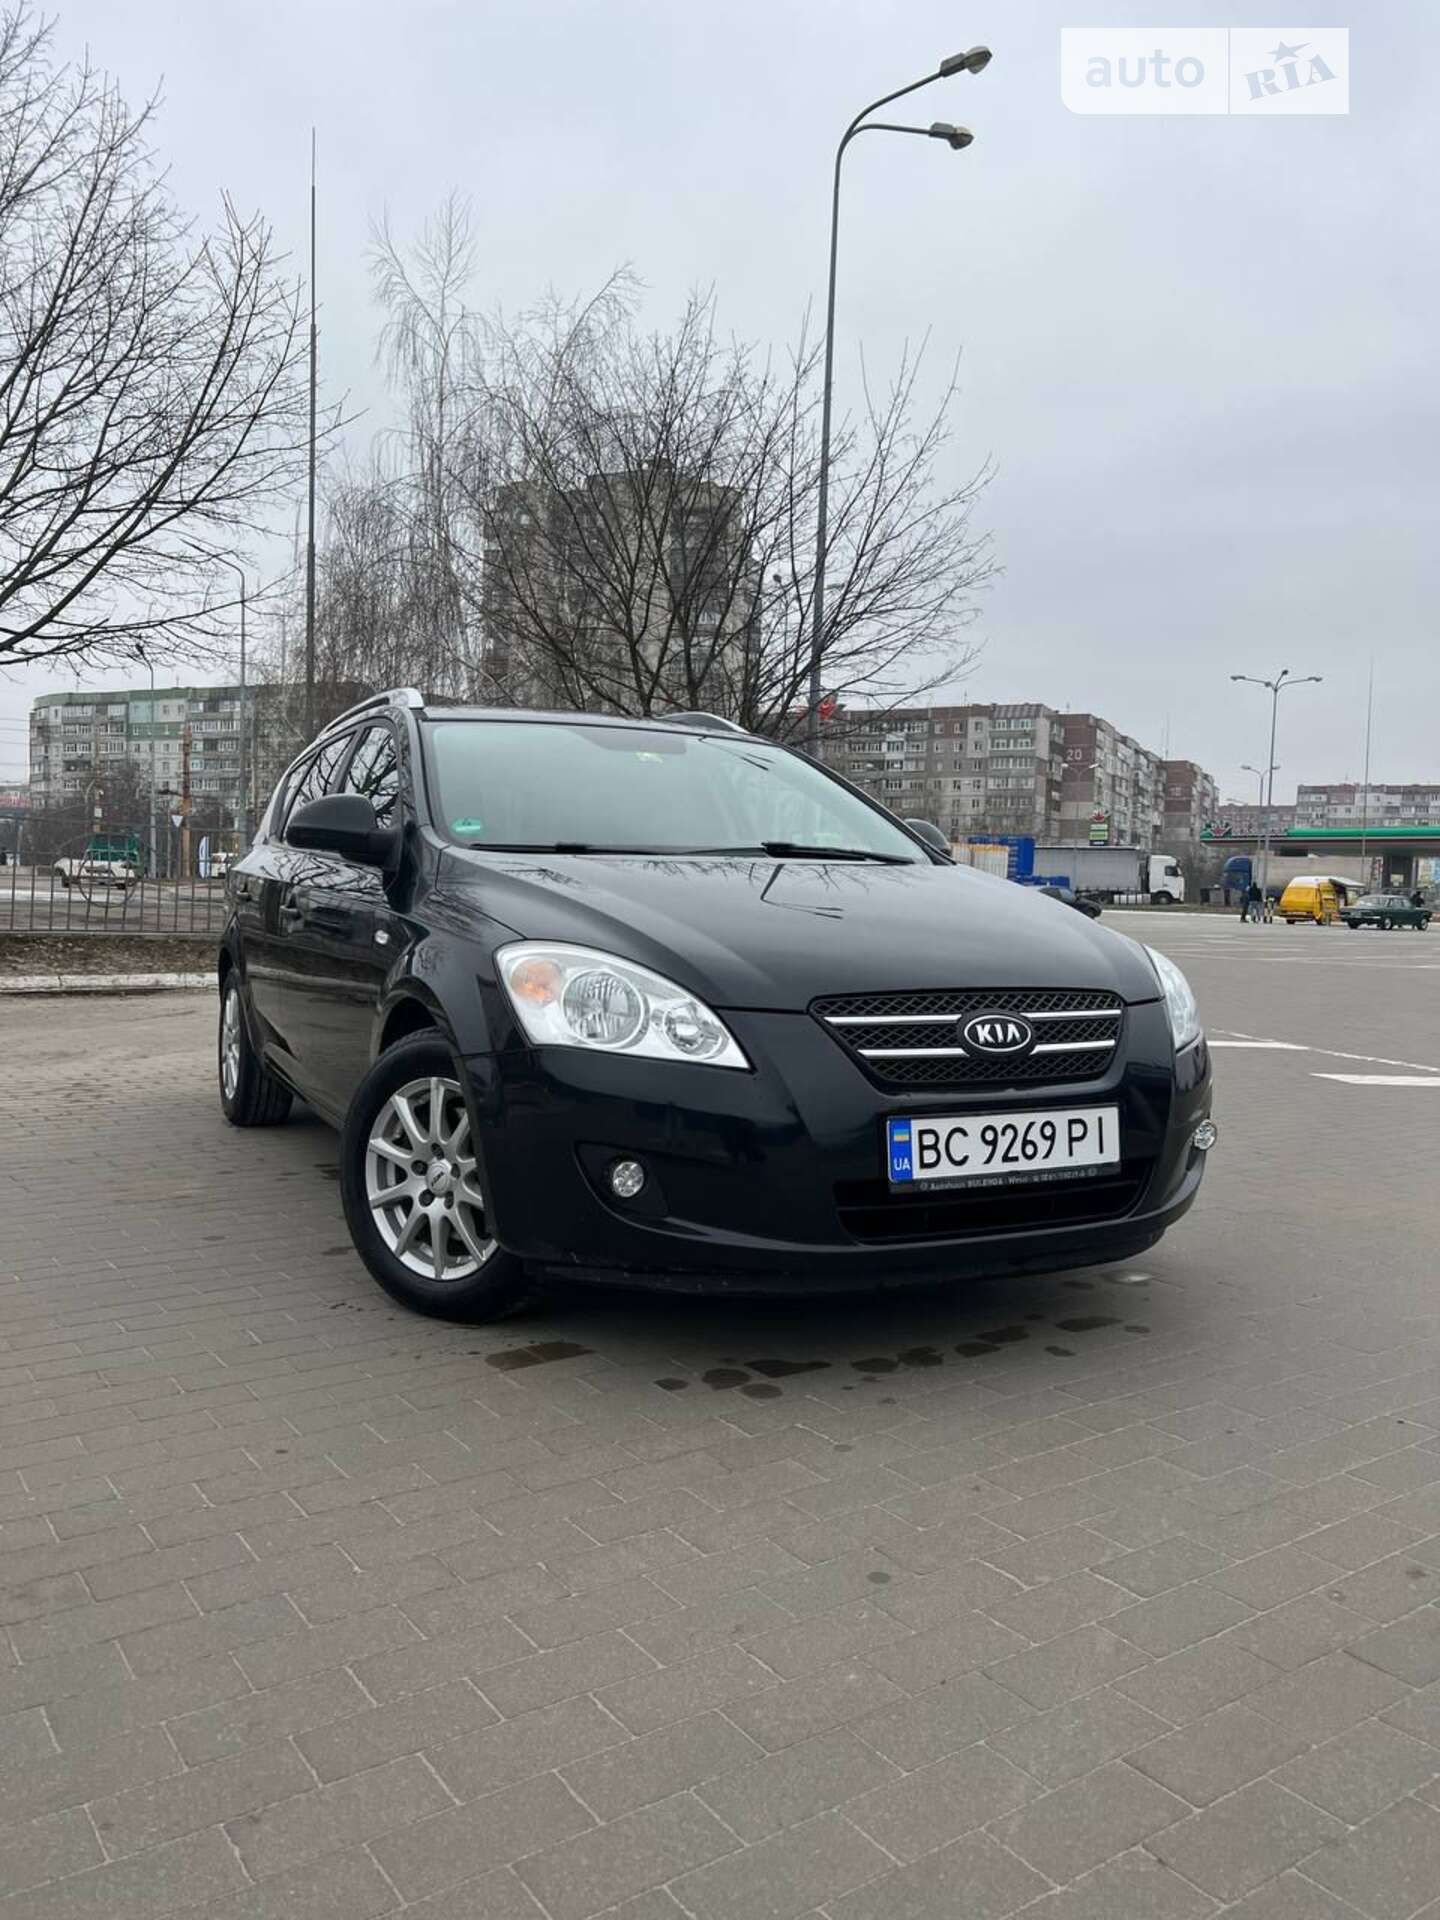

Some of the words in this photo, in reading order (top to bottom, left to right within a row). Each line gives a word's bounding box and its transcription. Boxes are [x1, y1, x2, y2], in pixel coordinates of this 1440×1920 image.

[1066, 748, 1082, 760] 20
[976, 1022, 1021, 1044] KIA
[918, 1127, 969, 1169] BC
[981, 1120, 1056, 1164] 9269
[1068, 1116, 1104, 1157] PI
[894, 1157, 911, 1171] UA
